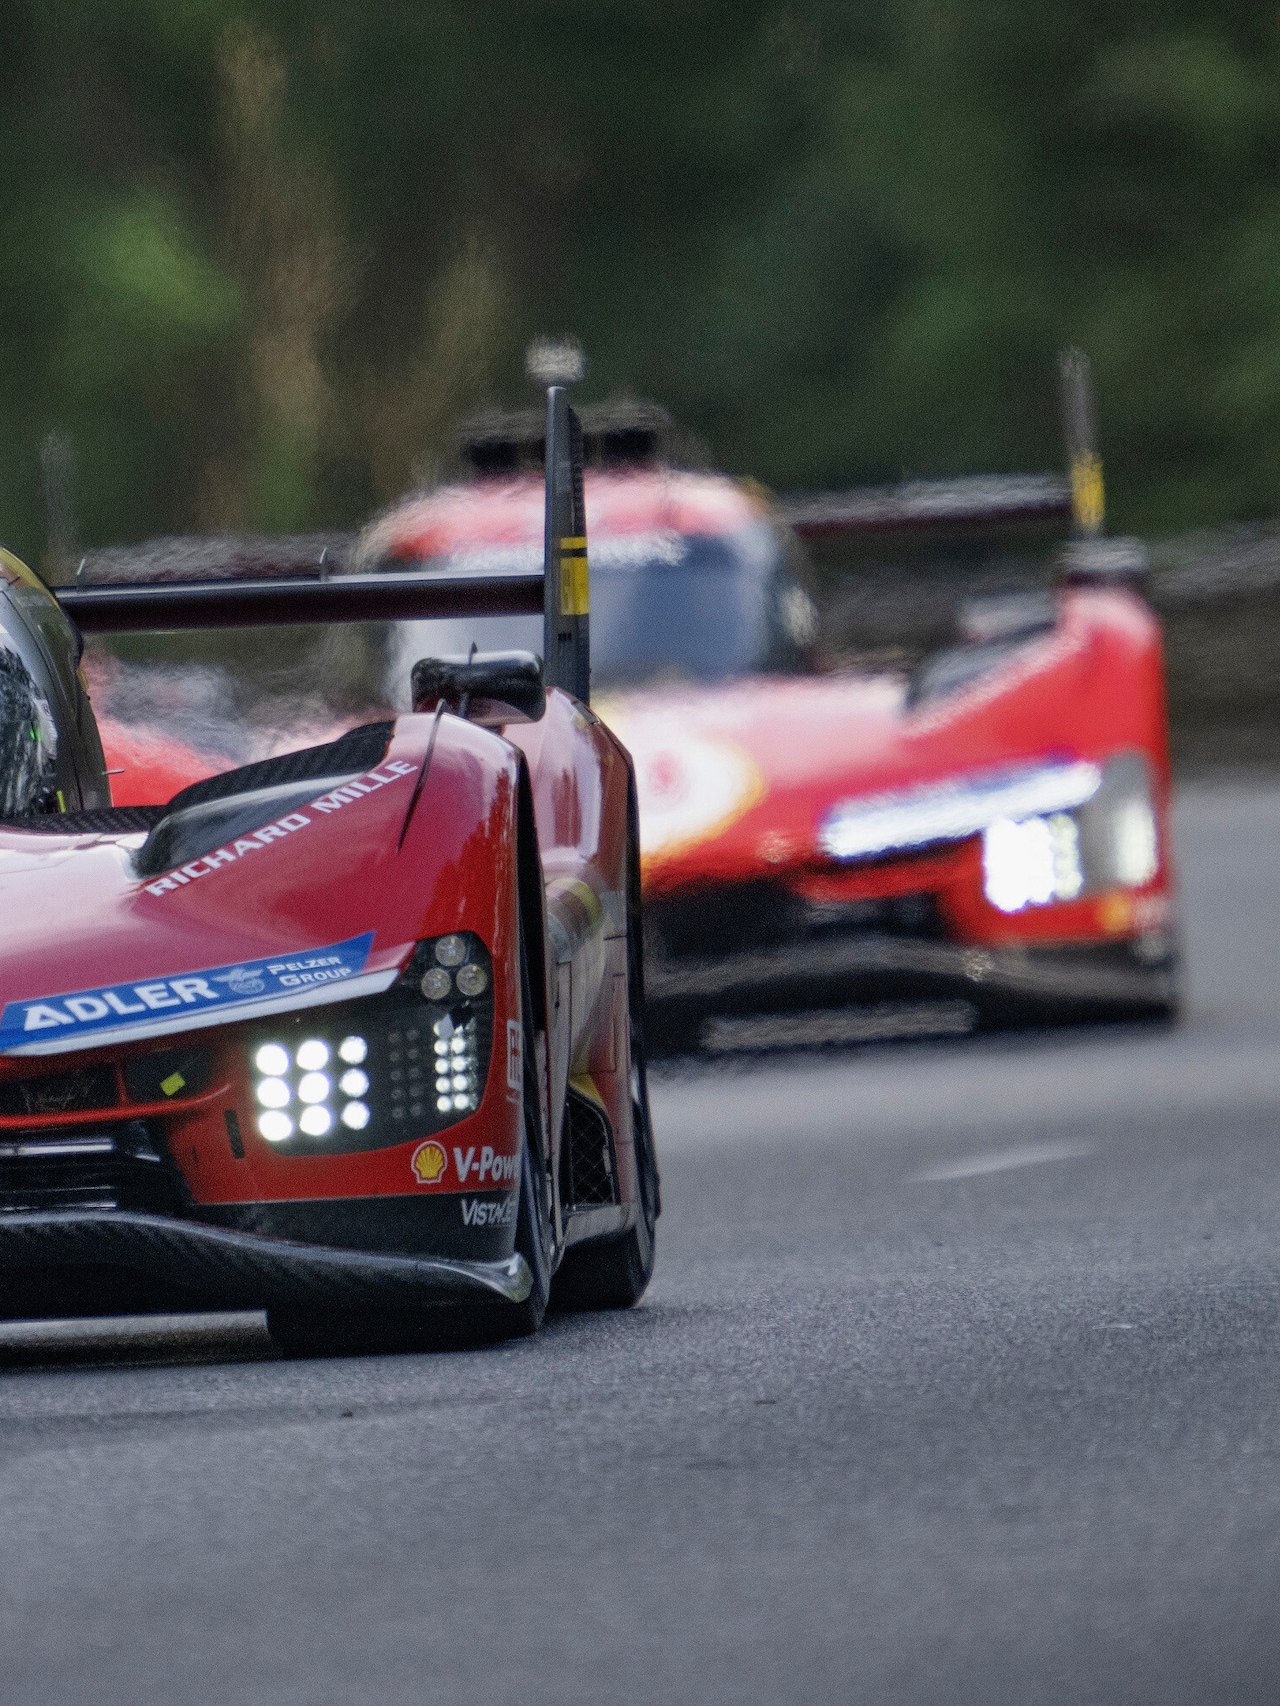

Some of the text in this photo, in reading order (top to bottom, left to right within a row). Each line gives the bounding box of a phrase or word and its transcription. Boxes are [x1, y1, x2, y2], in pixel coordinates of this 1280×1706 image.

[144, 760, 418, 896] RICHARD MILLE
[23, 977, 220, 1031] ADLER
